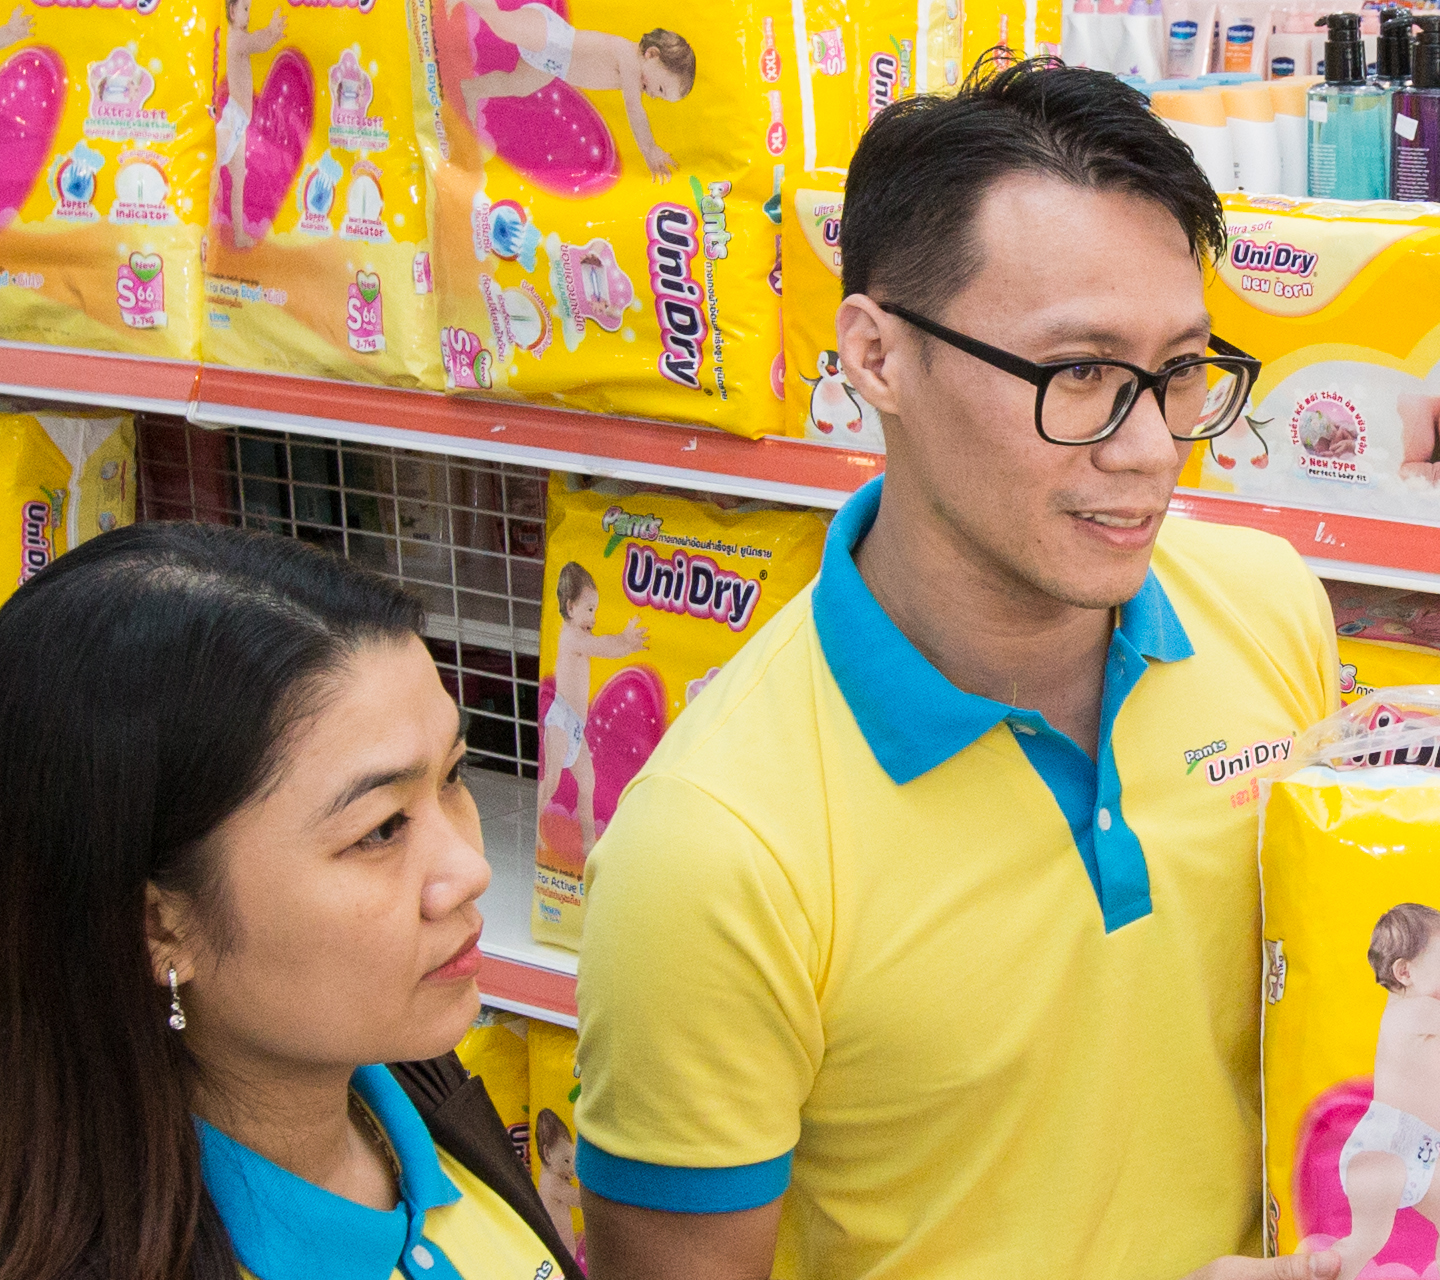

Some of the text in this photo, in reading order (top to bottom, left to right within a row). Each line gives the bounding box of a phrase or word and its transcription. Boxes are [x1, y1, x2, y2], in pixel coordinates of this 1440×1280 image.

[420, 13, 432, 58] Active
[763, 48, 779, 81] XXL
[769, 122, 786, 153] XL
[115, 209, 169, 222] Indicator
[706, 181, 732, 262] Pants
[1250, 220, 1273, 233] soft
[1231, 241, 1317, 277] UniDry
[117, 276, 156, 310] S 66
[649, 204, 706, 390] UniDry
[348, 297, 363, 327] S
[1331, 460, 1357, 473] type
[603, 506, 665, 542] Pants
[625, 548, 760, 629] UniDry
[1184, 739, 1228, 766] Pants
[1206, 736, 1294, 783] UniDry
[551, 875, 580, 896] Active
